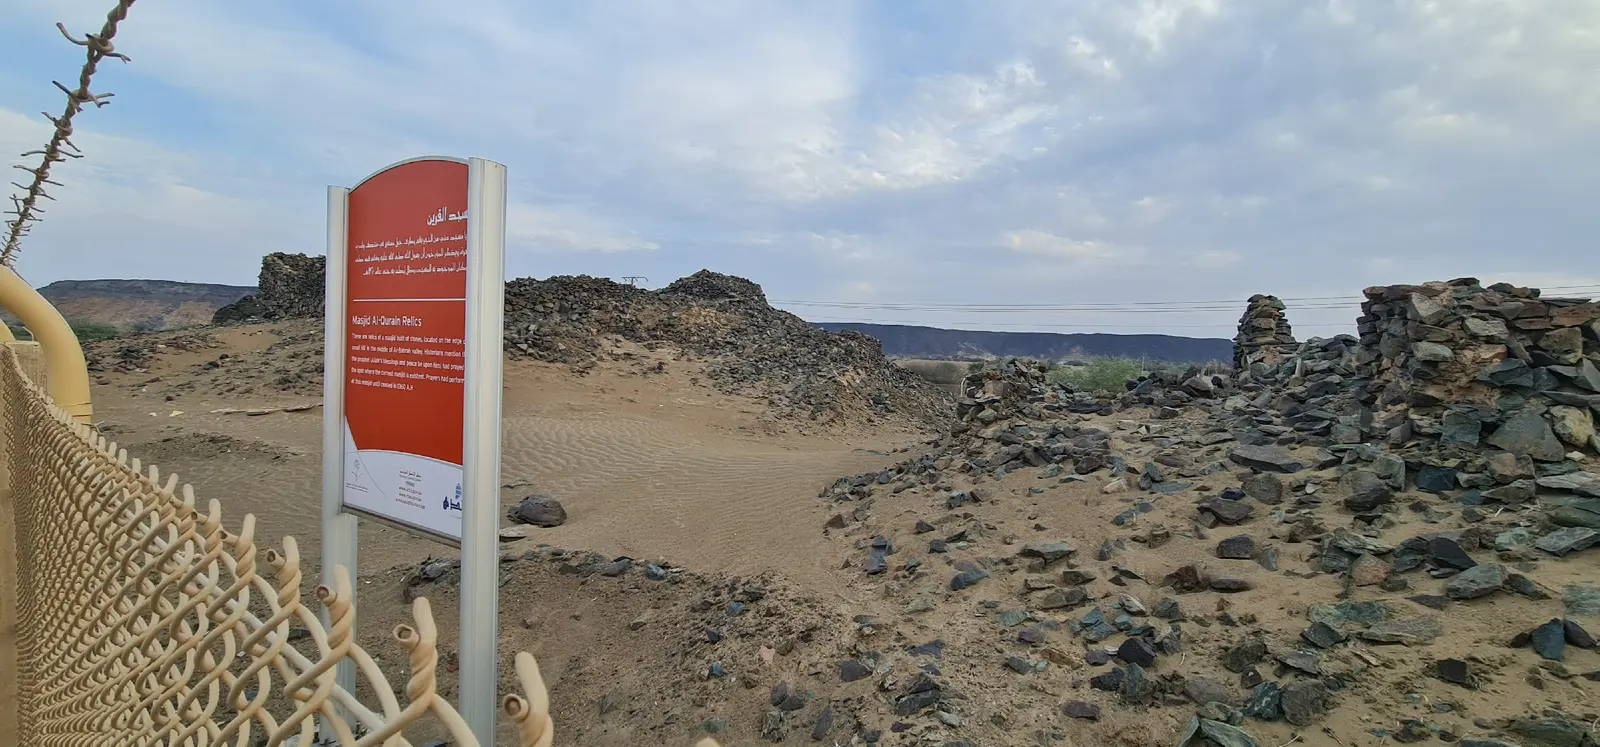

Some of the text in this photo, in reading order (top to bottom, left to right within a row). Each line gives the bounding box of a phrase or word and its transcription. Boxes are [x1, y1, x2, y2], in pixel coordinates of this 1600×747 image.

[427, 206, 467, 226] سجد القرين
[352, 316, 422, 327] Masjid Al-Qurain Relics
